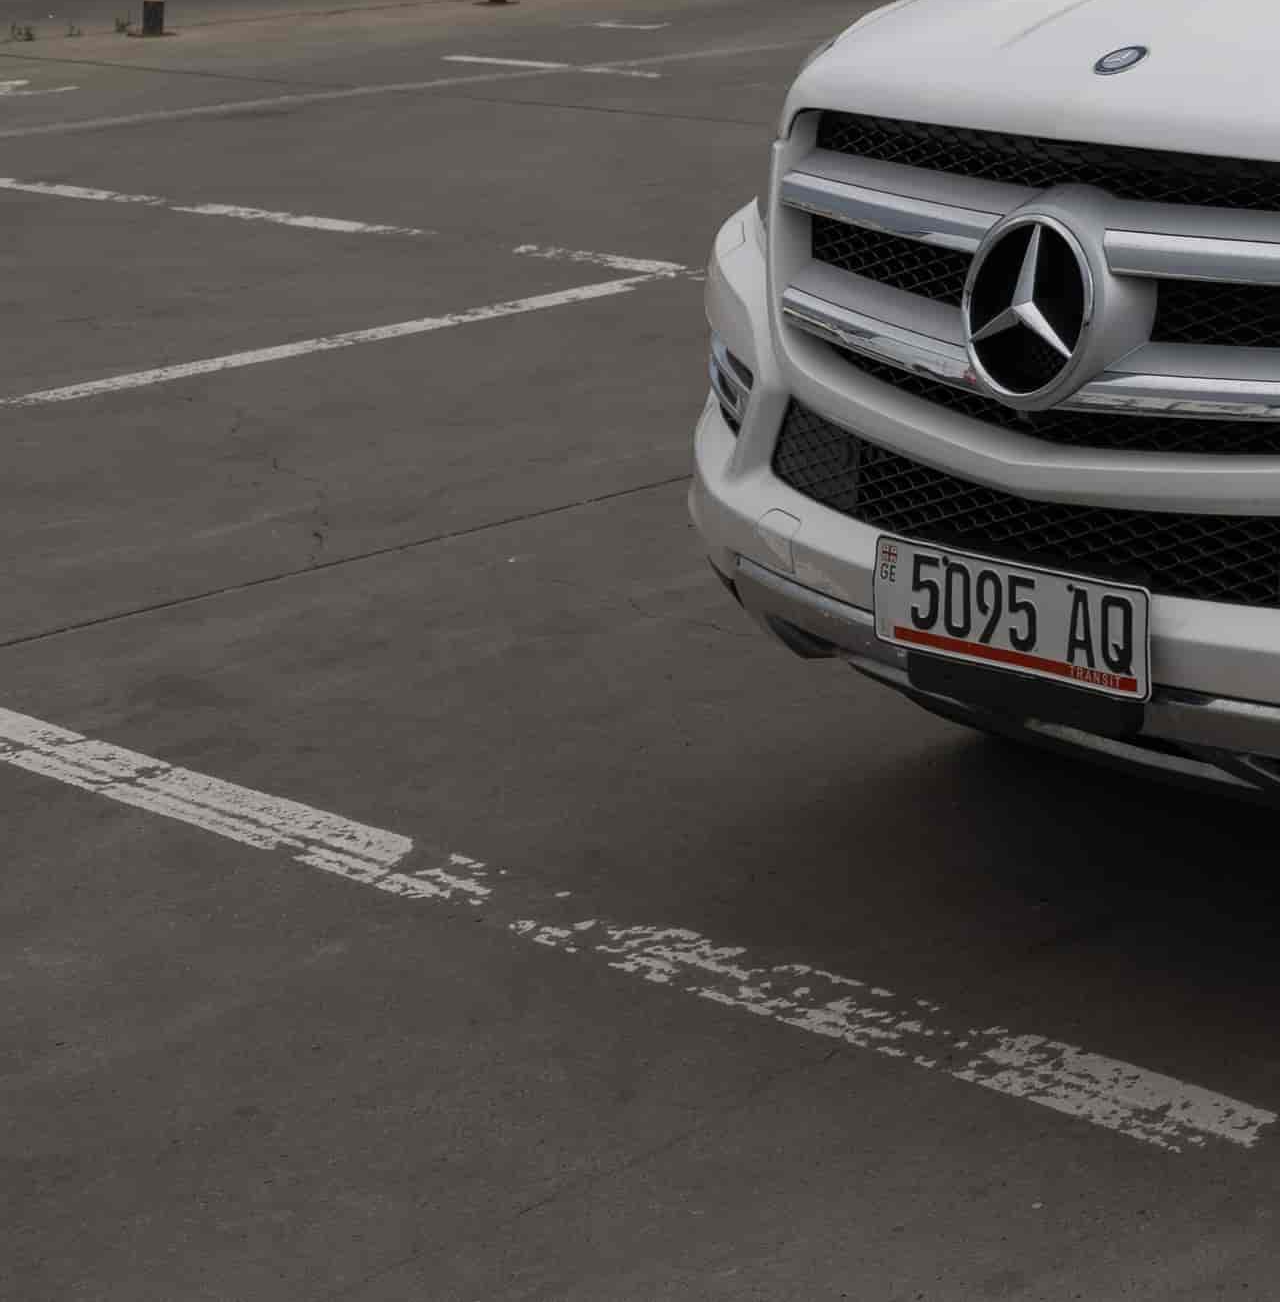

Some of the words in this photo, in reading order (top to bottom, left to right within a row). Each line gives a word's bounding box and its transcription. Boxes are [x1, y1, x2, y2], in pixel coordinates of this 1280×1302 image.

[879, 562, 897, 583] GE
[910, 552, 1038, 653] 5095
[1066, 583, 1134, 676] AQ
